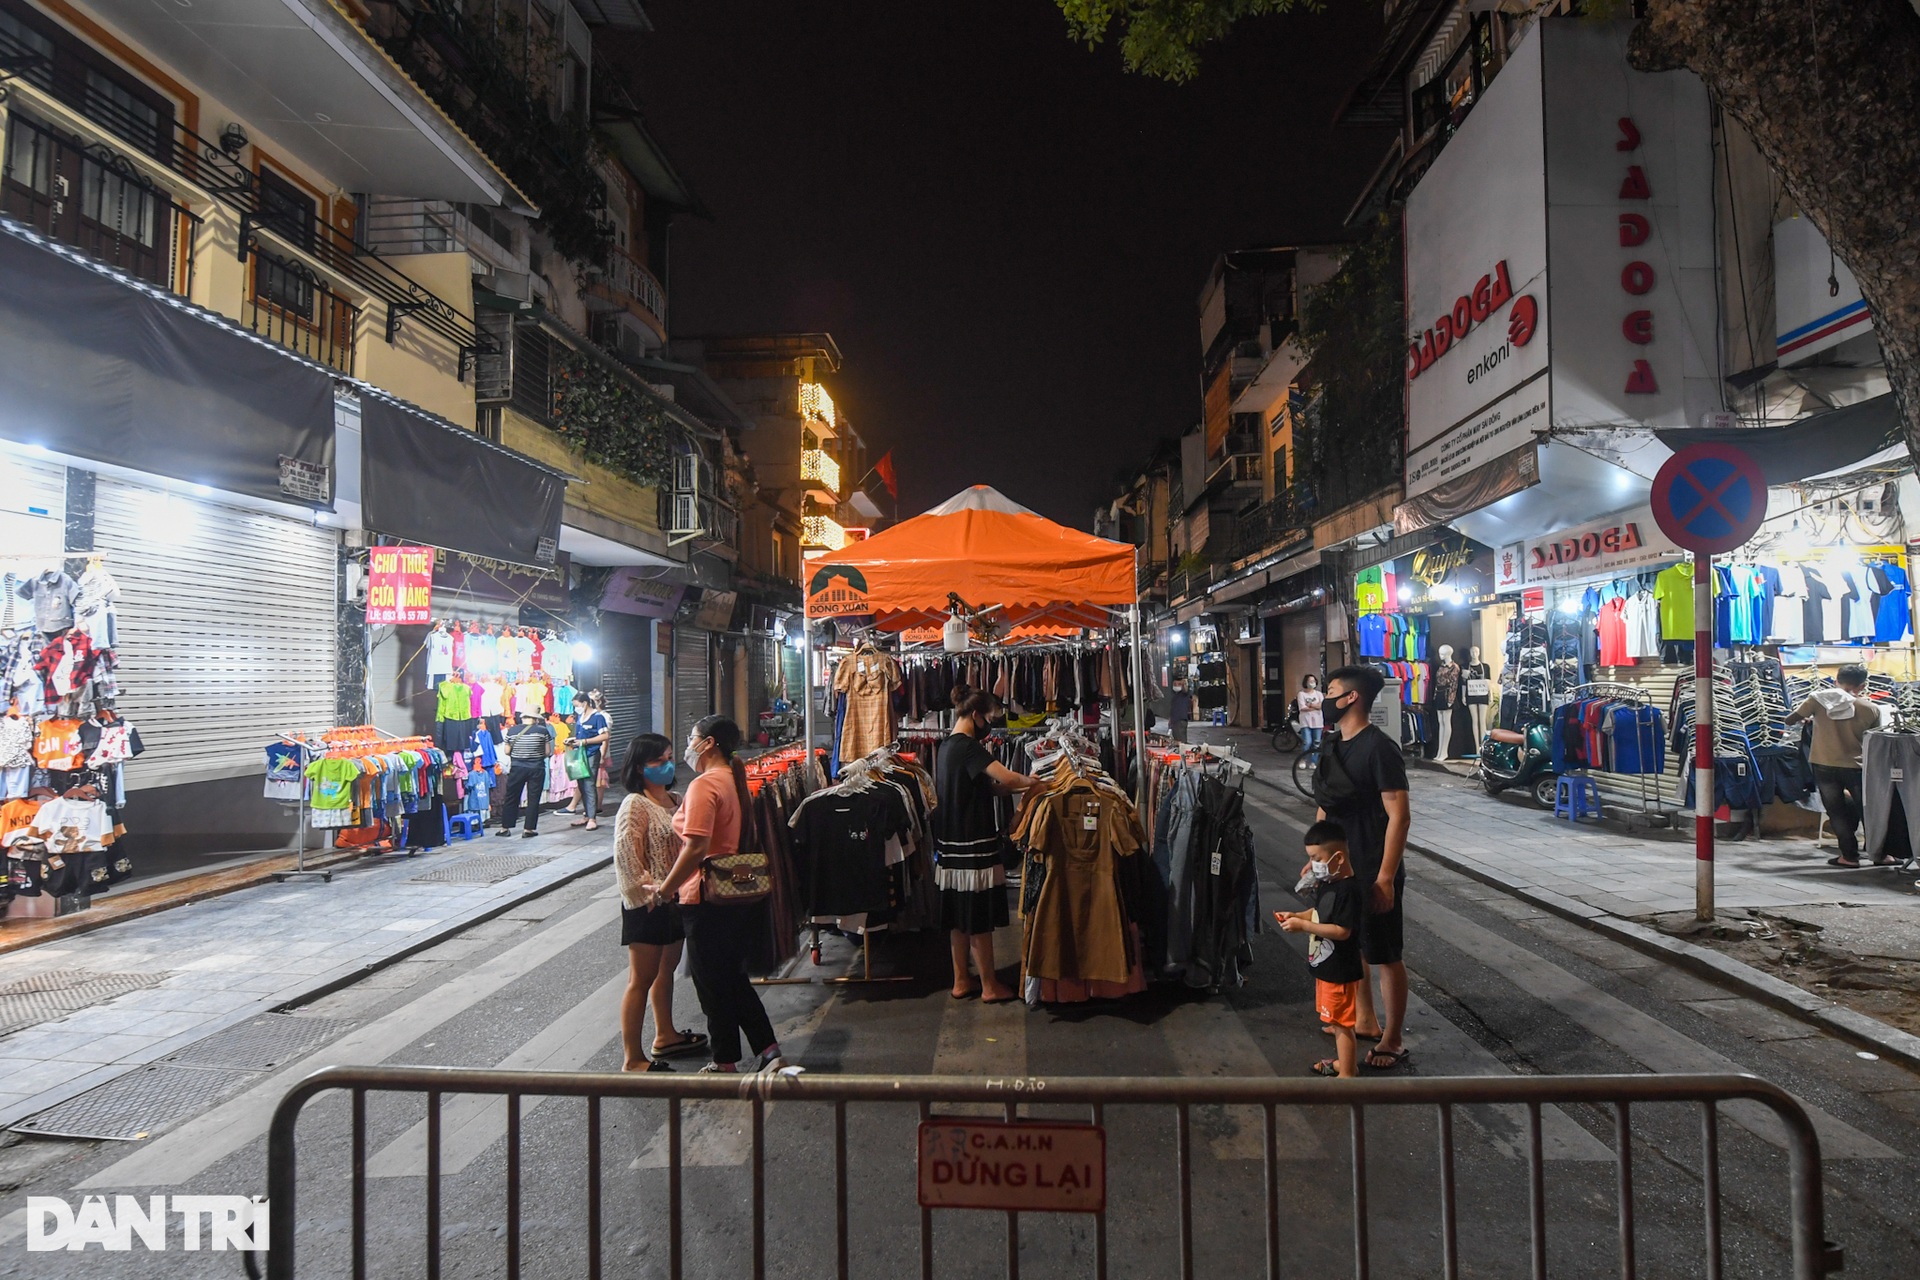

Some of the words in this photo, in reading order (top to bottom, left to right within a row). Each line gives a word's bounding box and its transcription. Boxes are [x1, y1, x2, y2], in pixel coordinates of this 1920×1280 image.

[1408, 259, 1513, 379] SADOGA
[1467, 338, 1511, 385] enkoni
[374, 552, 397, 574] CHO
[401, 550, 429, 574] THUÊ
[1531, 522, 1643, 569] SADOGA
[370, 578, 395, 607] CỬA
[810, 603, 839, 614] DONG
[842, 602, 869, 613] XUAN
[38, 737, 60, 754] CAN
[932, 1150, 1027, 1187] DỪNG
[1036, 1163, 1091, 1194] LẠI
